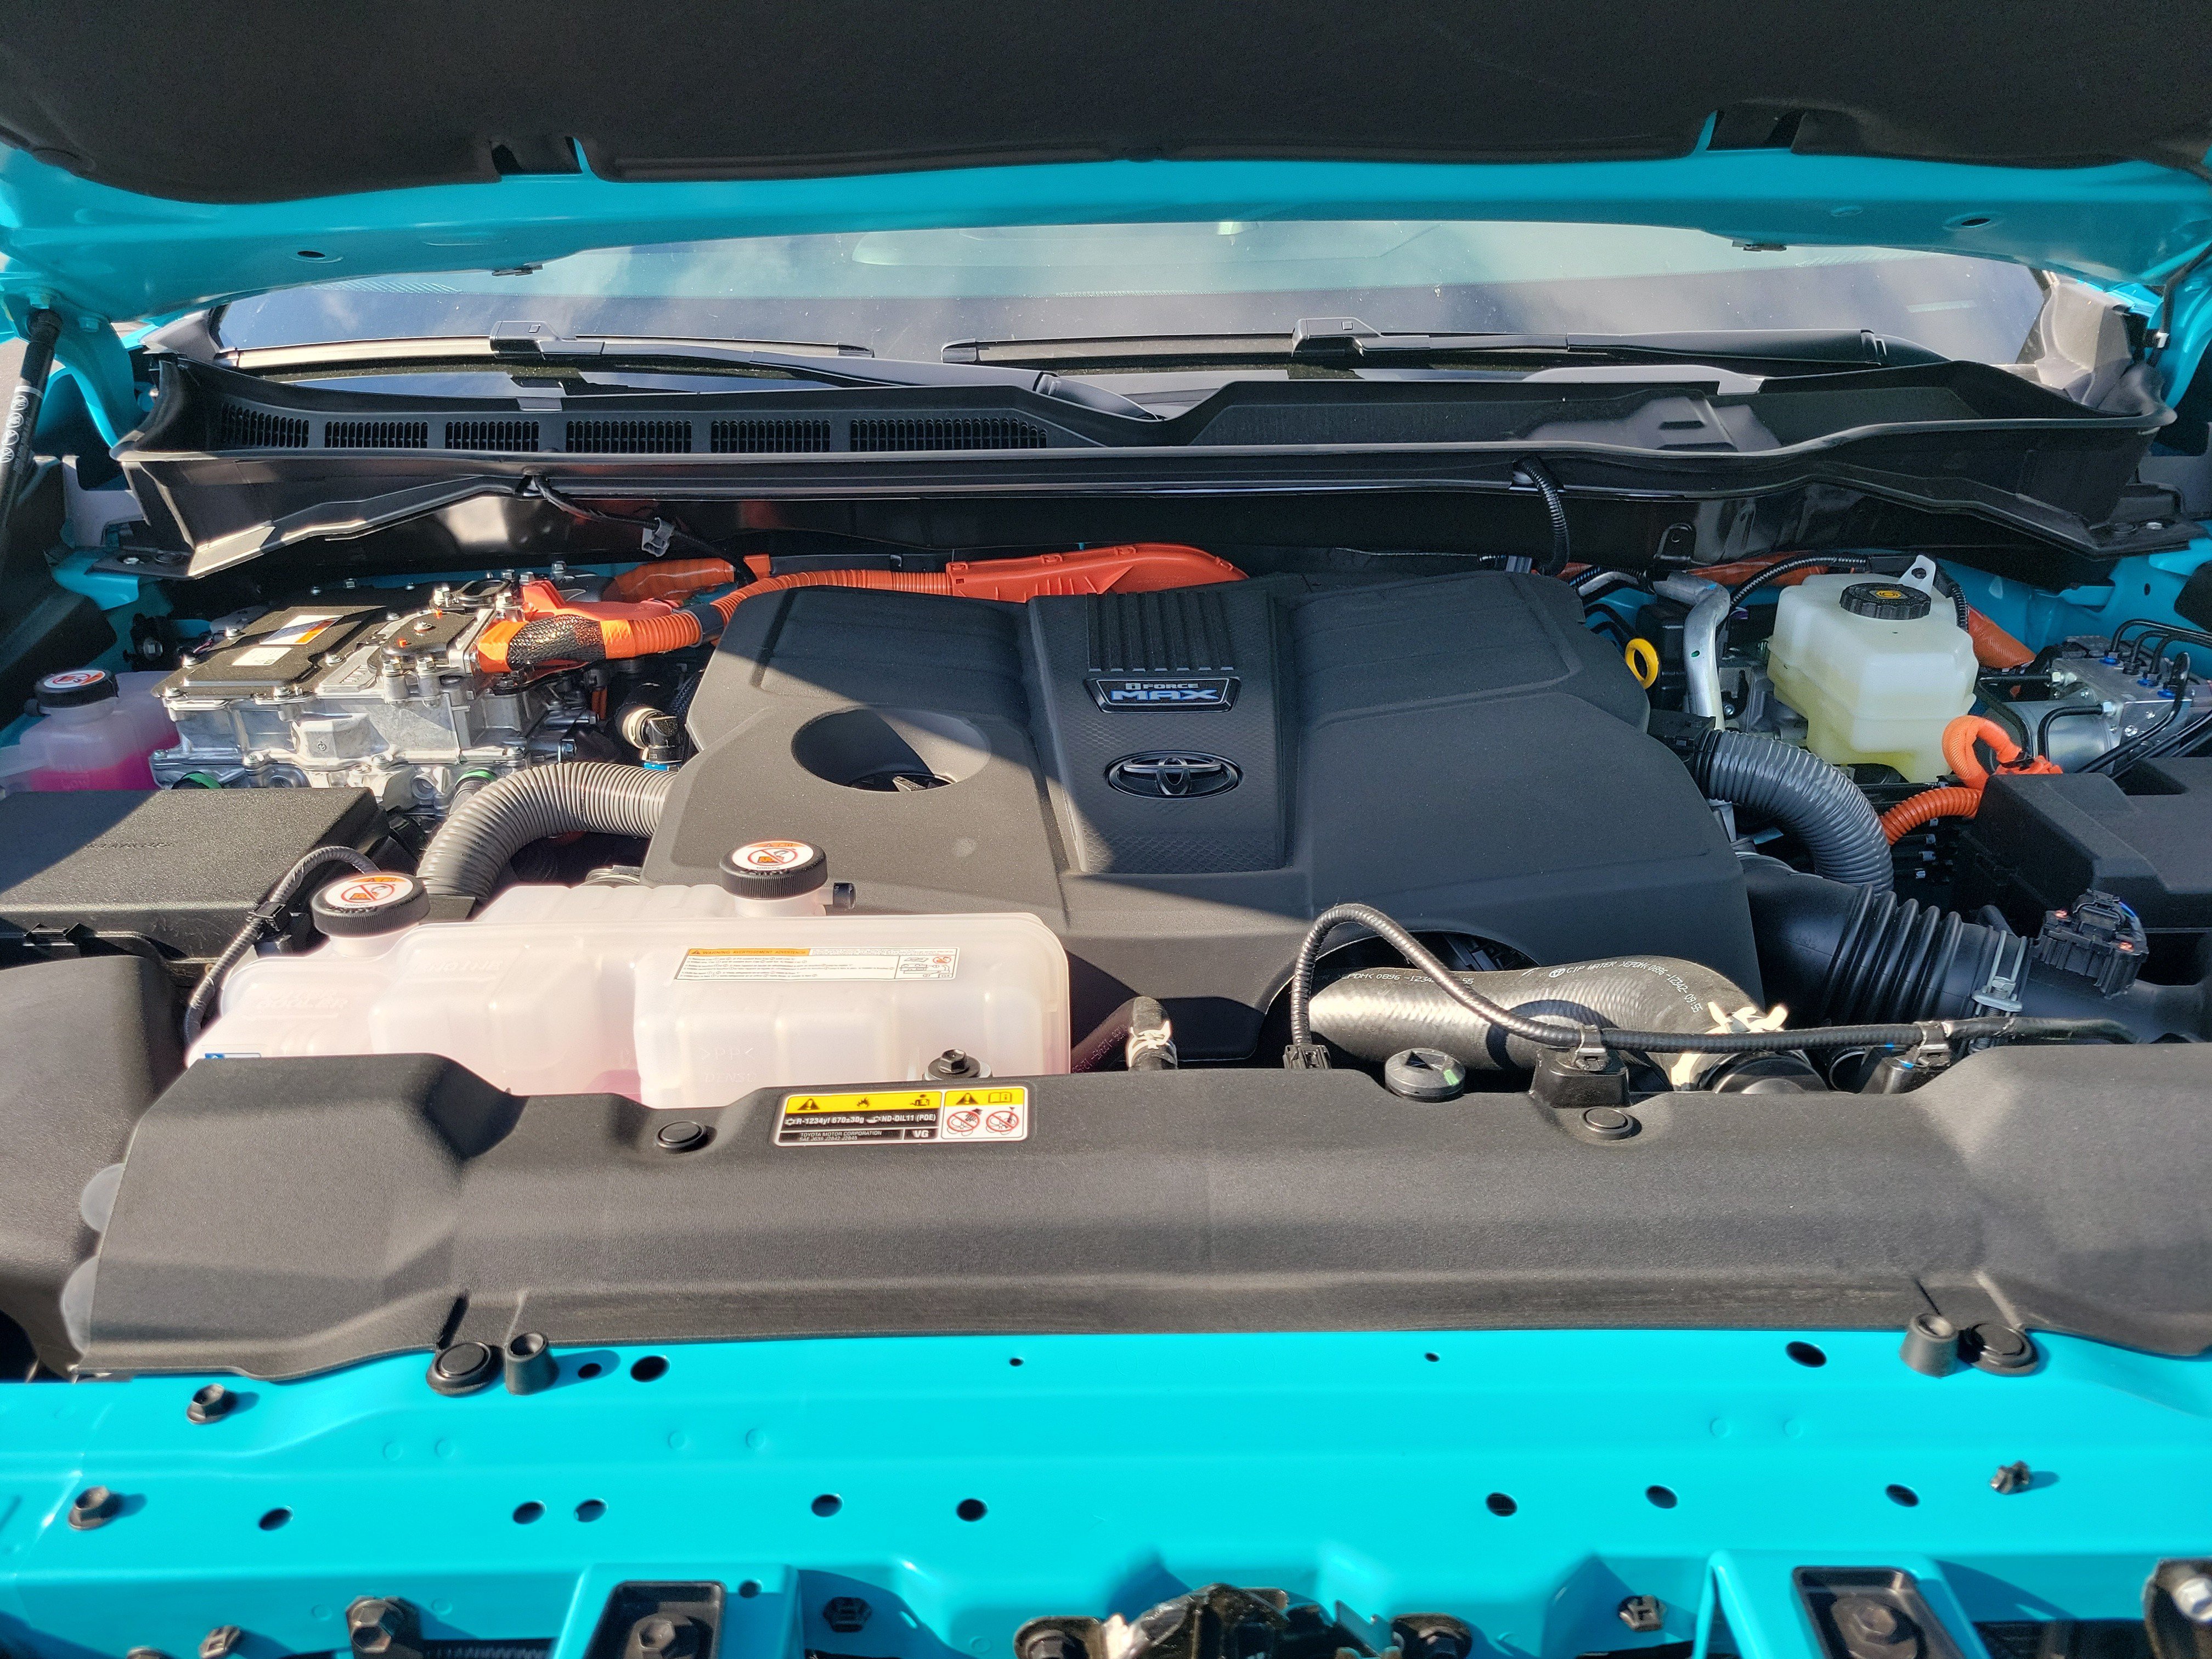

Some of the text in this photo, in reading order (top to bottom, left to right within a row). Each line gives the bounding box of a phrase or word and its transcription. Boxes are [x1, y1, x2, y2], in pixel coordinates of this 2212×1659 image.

[1110, 689, 1219, 701] MAX
[832, 1116, 865, 1124] 670±30g
[917, 1114, 936, 1122] (POE)
[912, 1130, 929, 1138] VG
